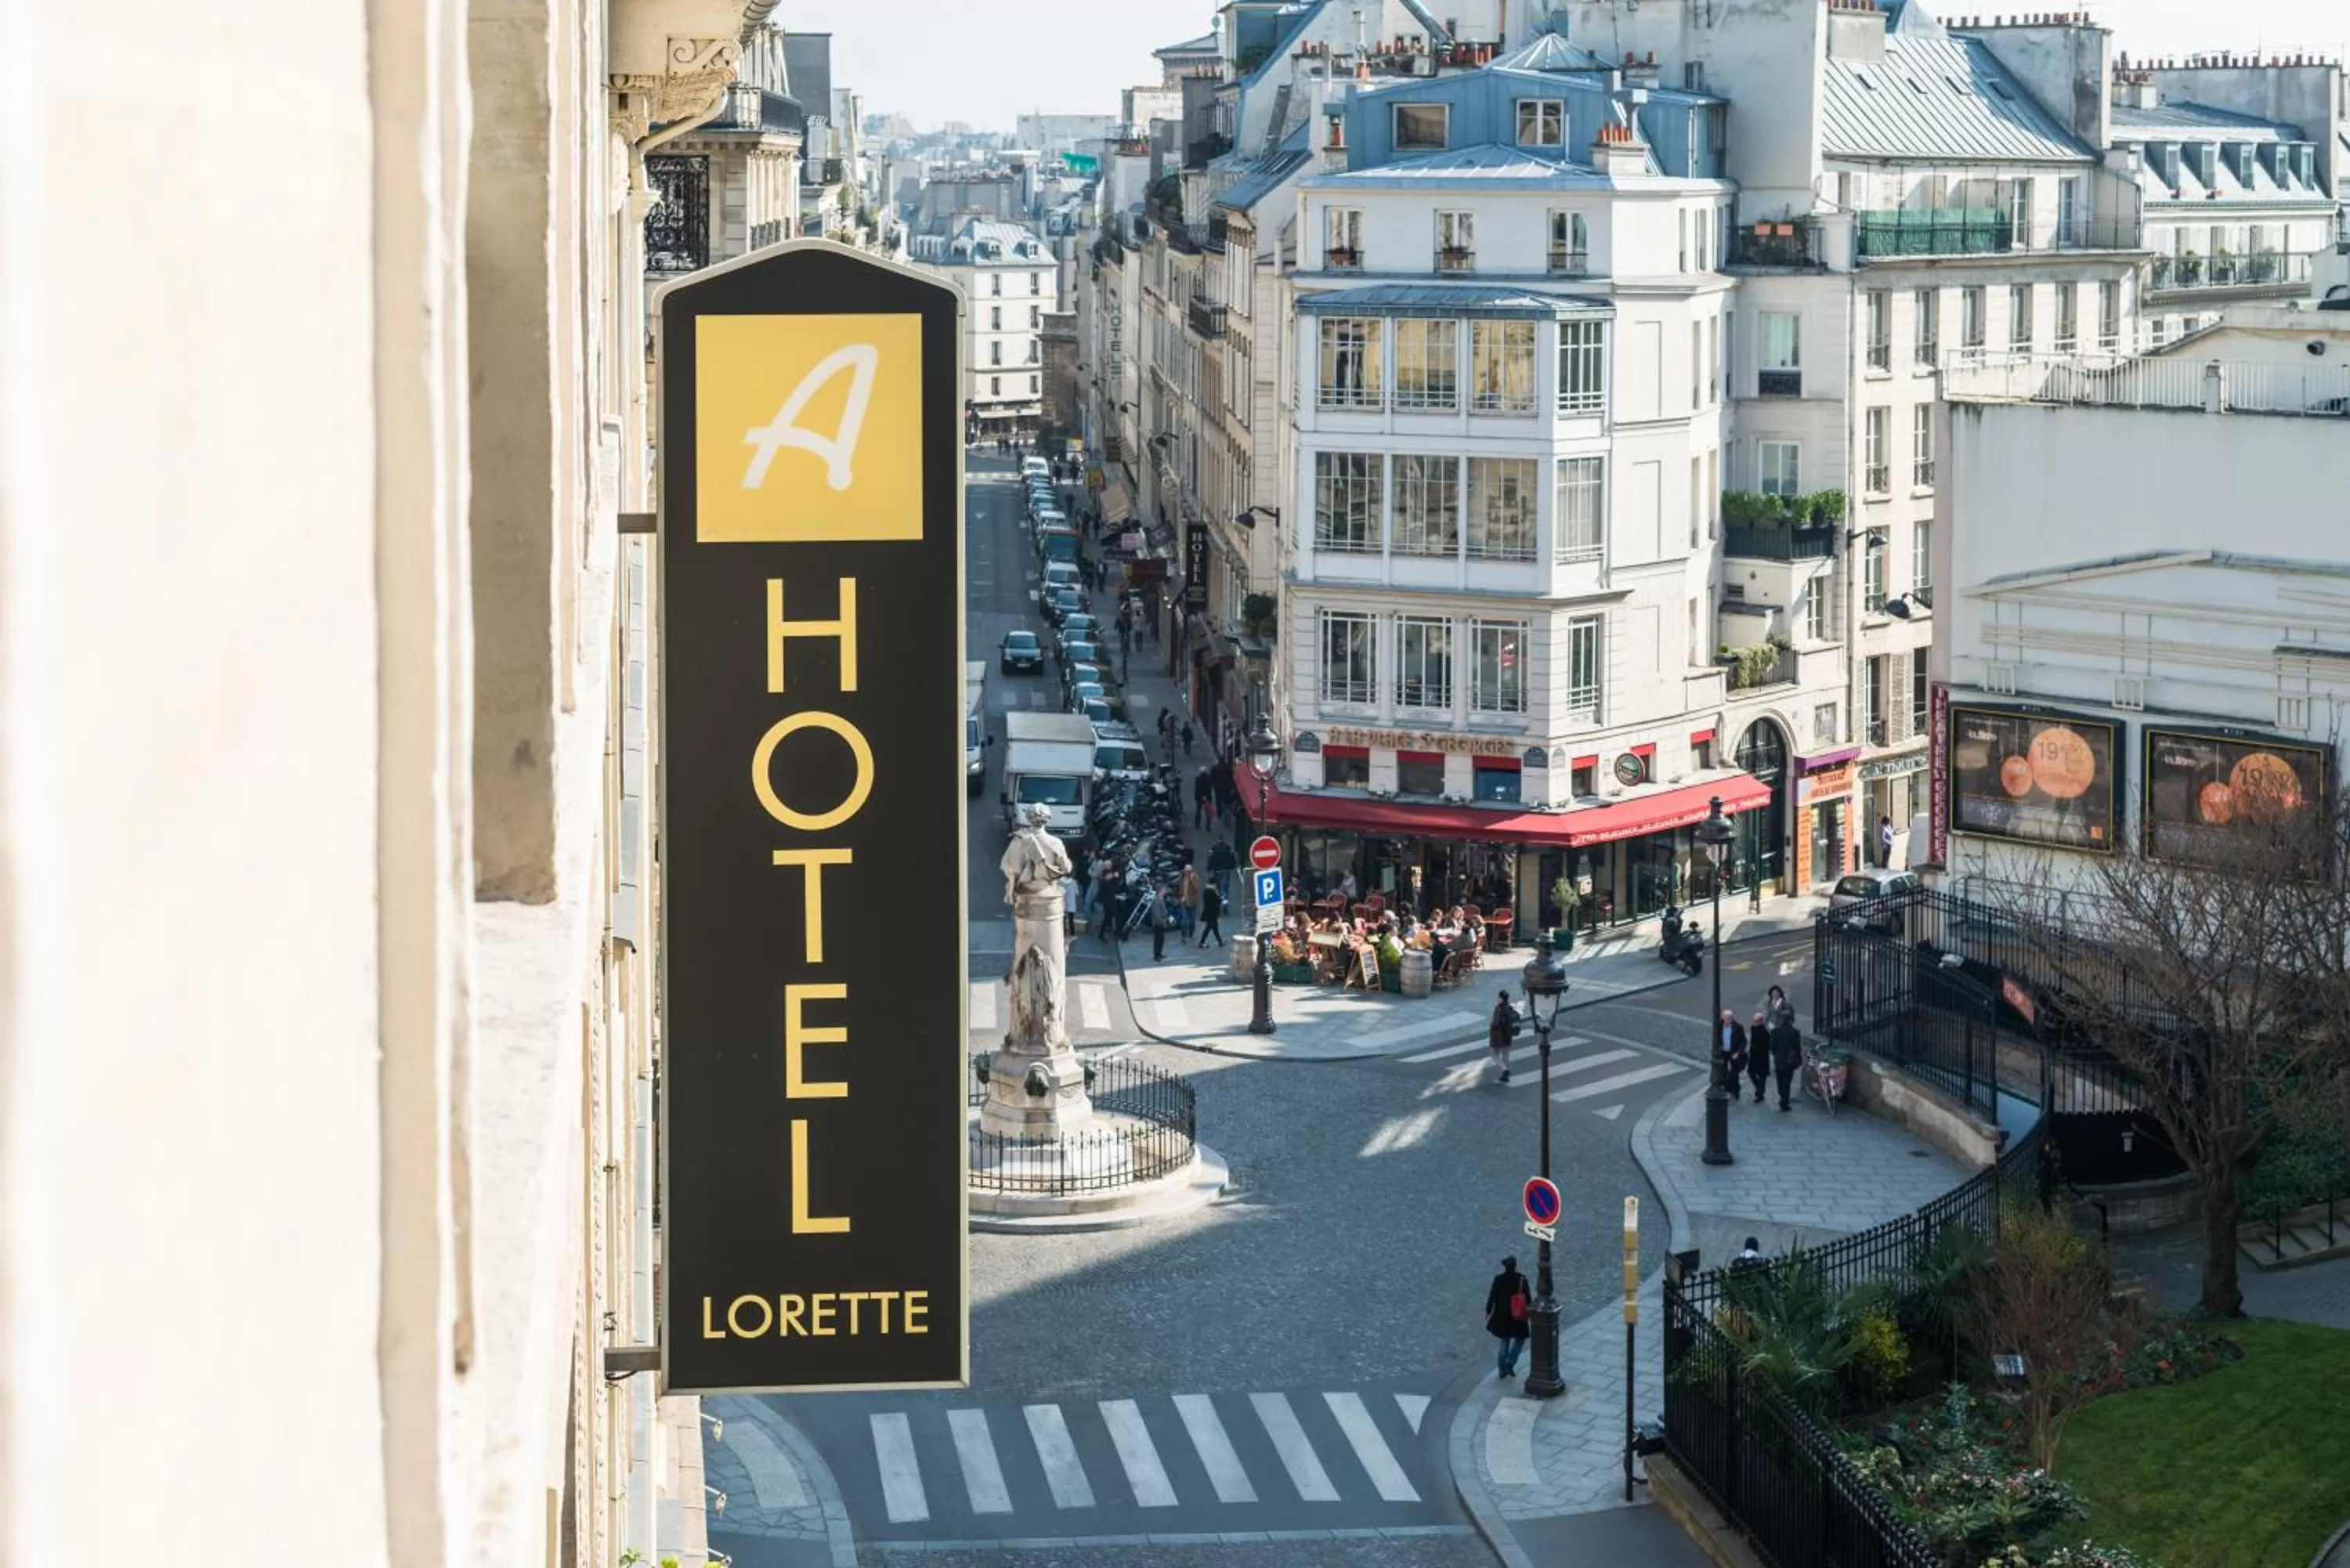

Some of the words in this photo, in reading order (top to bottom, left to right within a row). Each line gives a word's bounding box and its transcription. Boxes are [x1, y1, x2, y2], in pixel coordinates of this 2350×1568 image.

[742, 344, 878, 491] A
[1191, 532, 1203, 583] HOTEL
[752, 577, 874, 1234] HOTEL
[1263, 877, 1275, 900] P
[703, 1291, 927, 1338] LORETTE
